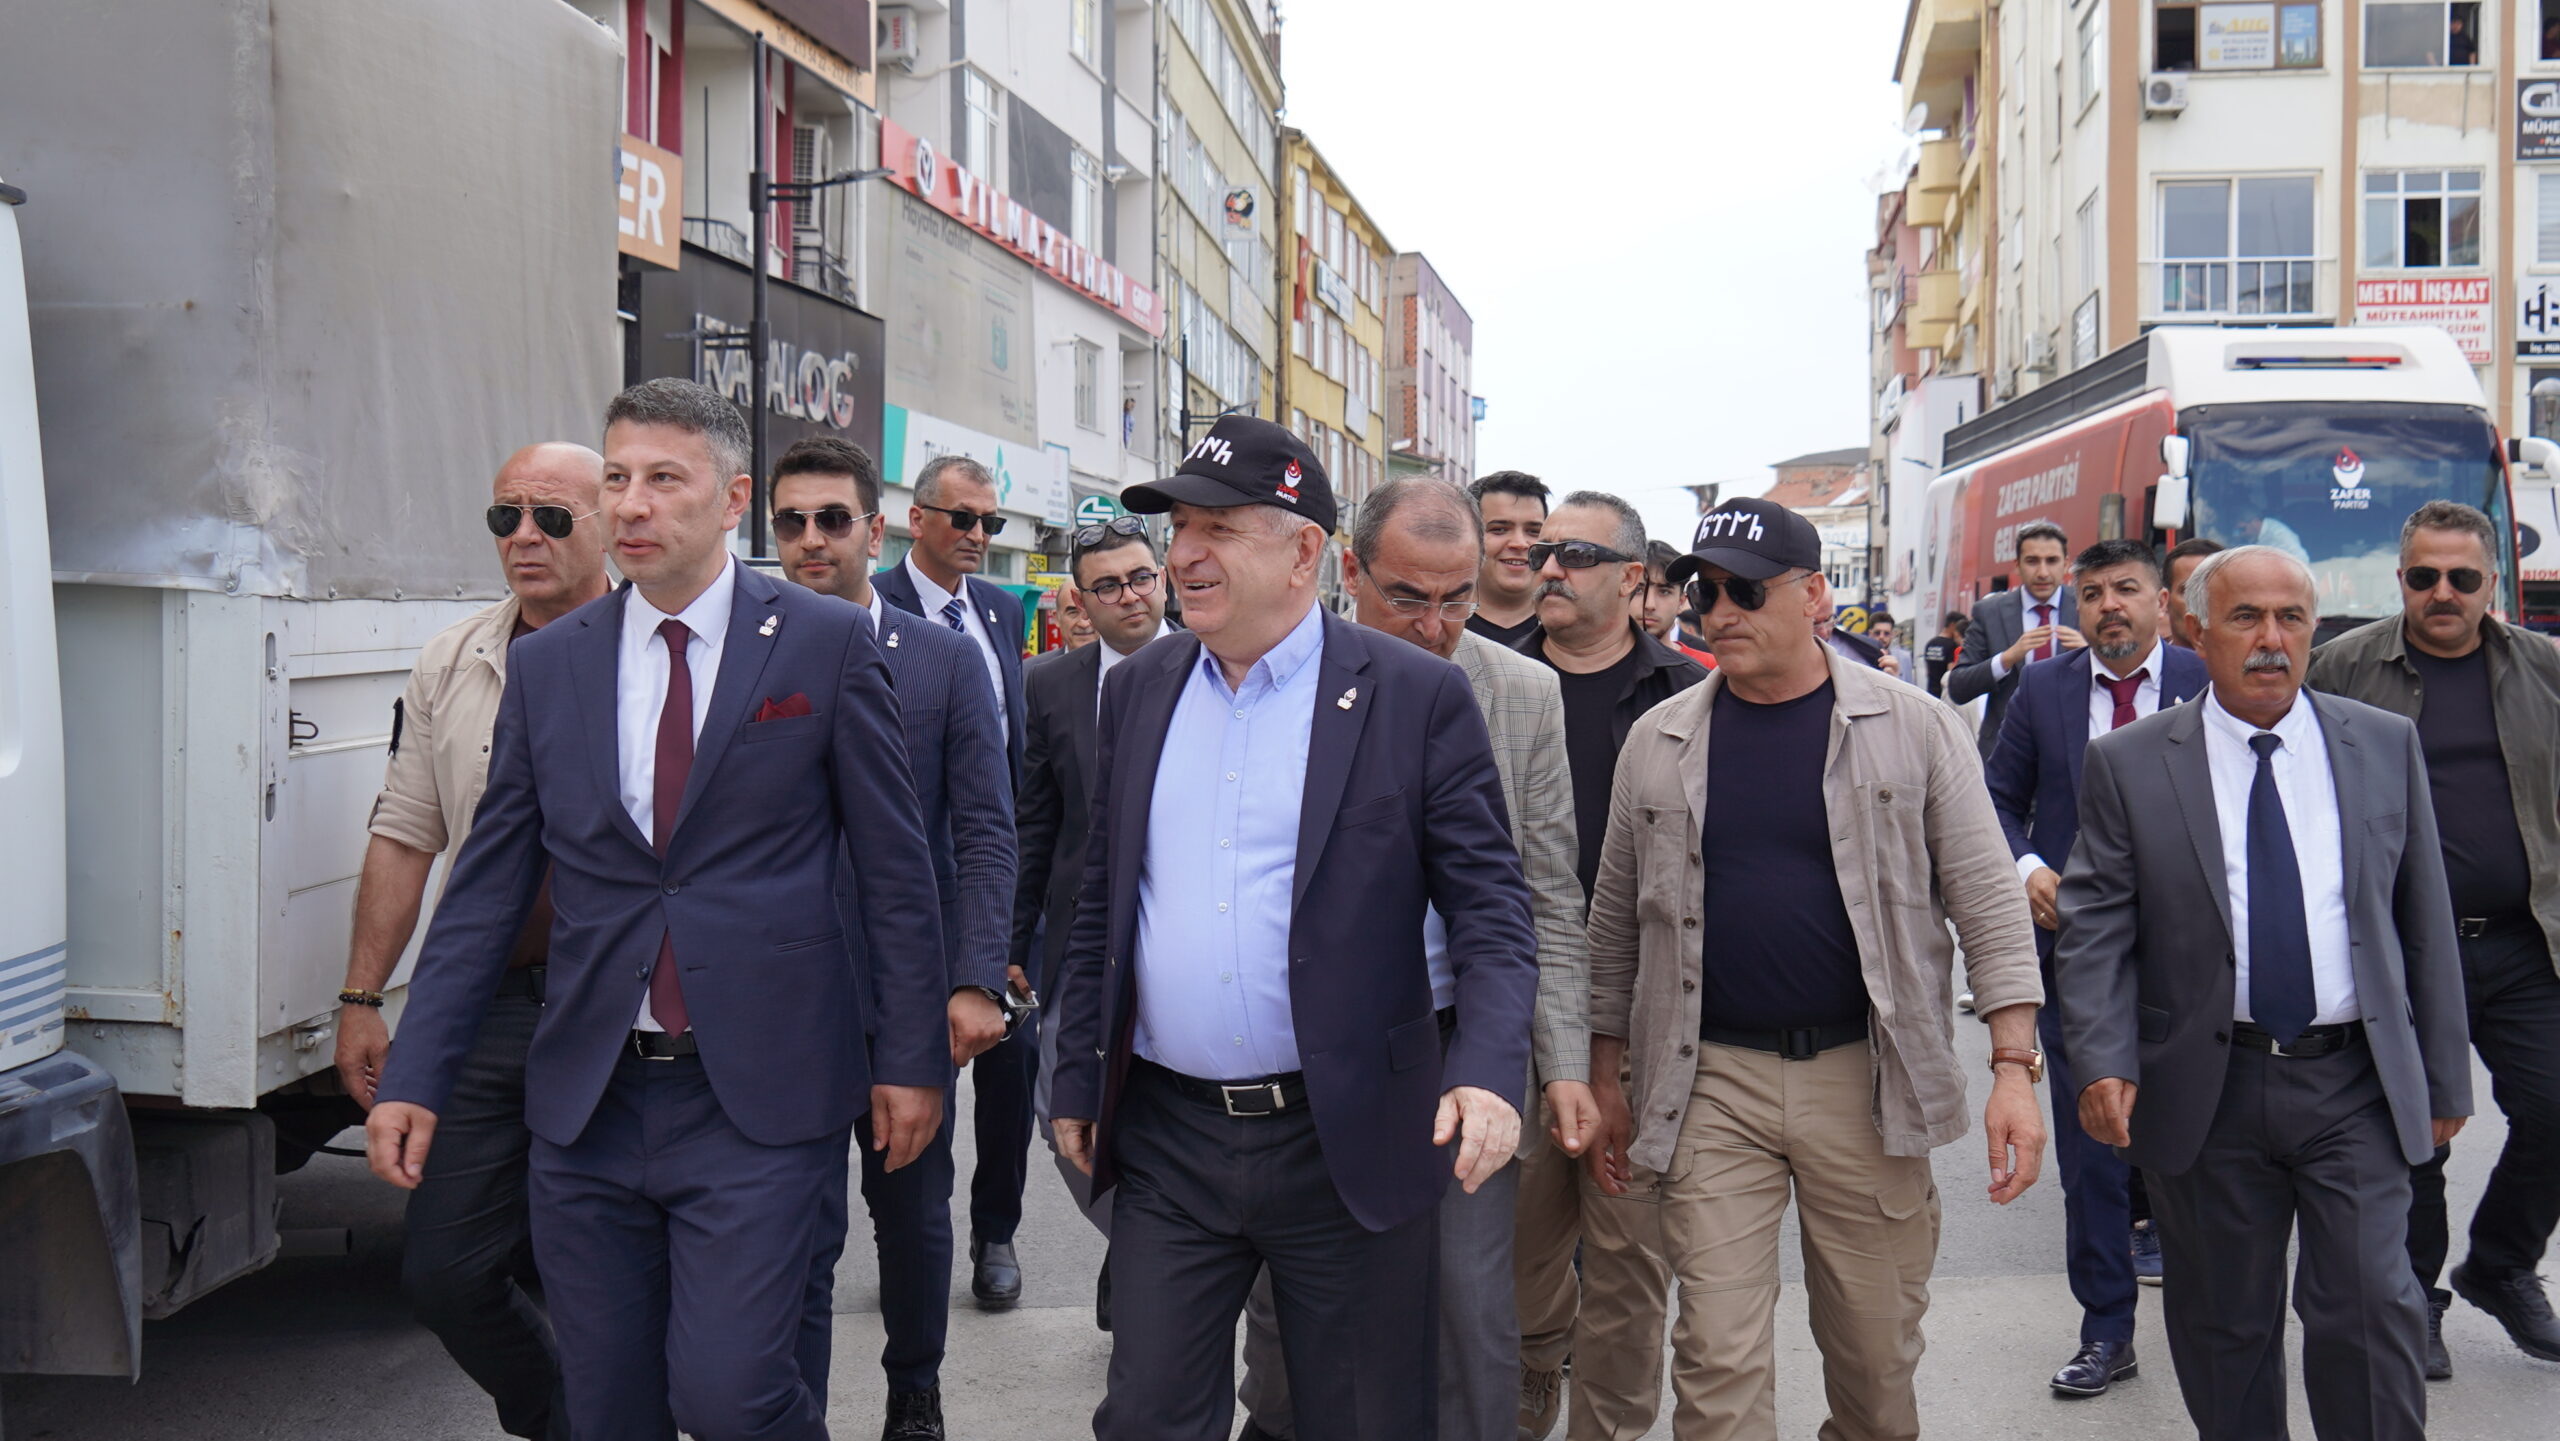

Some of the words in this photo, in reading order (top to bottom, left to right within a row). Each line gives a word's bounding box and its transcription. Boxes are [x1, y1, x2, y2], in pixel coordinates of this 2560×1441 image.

[957, 166, 1057, 267] YILMAZ
[1060, 236, 1124, 308] İLHAN
[2358, 281, 2416, 304] METİN
[2422, 280, 2488, 305] İNŞAAT
[2366, 308, 2479, 321] MÜTEAHHİTLİK
[696, 313, 856, 429] KAALOG
[1996, 477, 2031, 518] ZAFER
[2031, 450, 2080, 508] PARTİSİ
[2330, 488, 2371, 500] ZAFER
[2334, 500, 2369, 510] PARTİSİ
